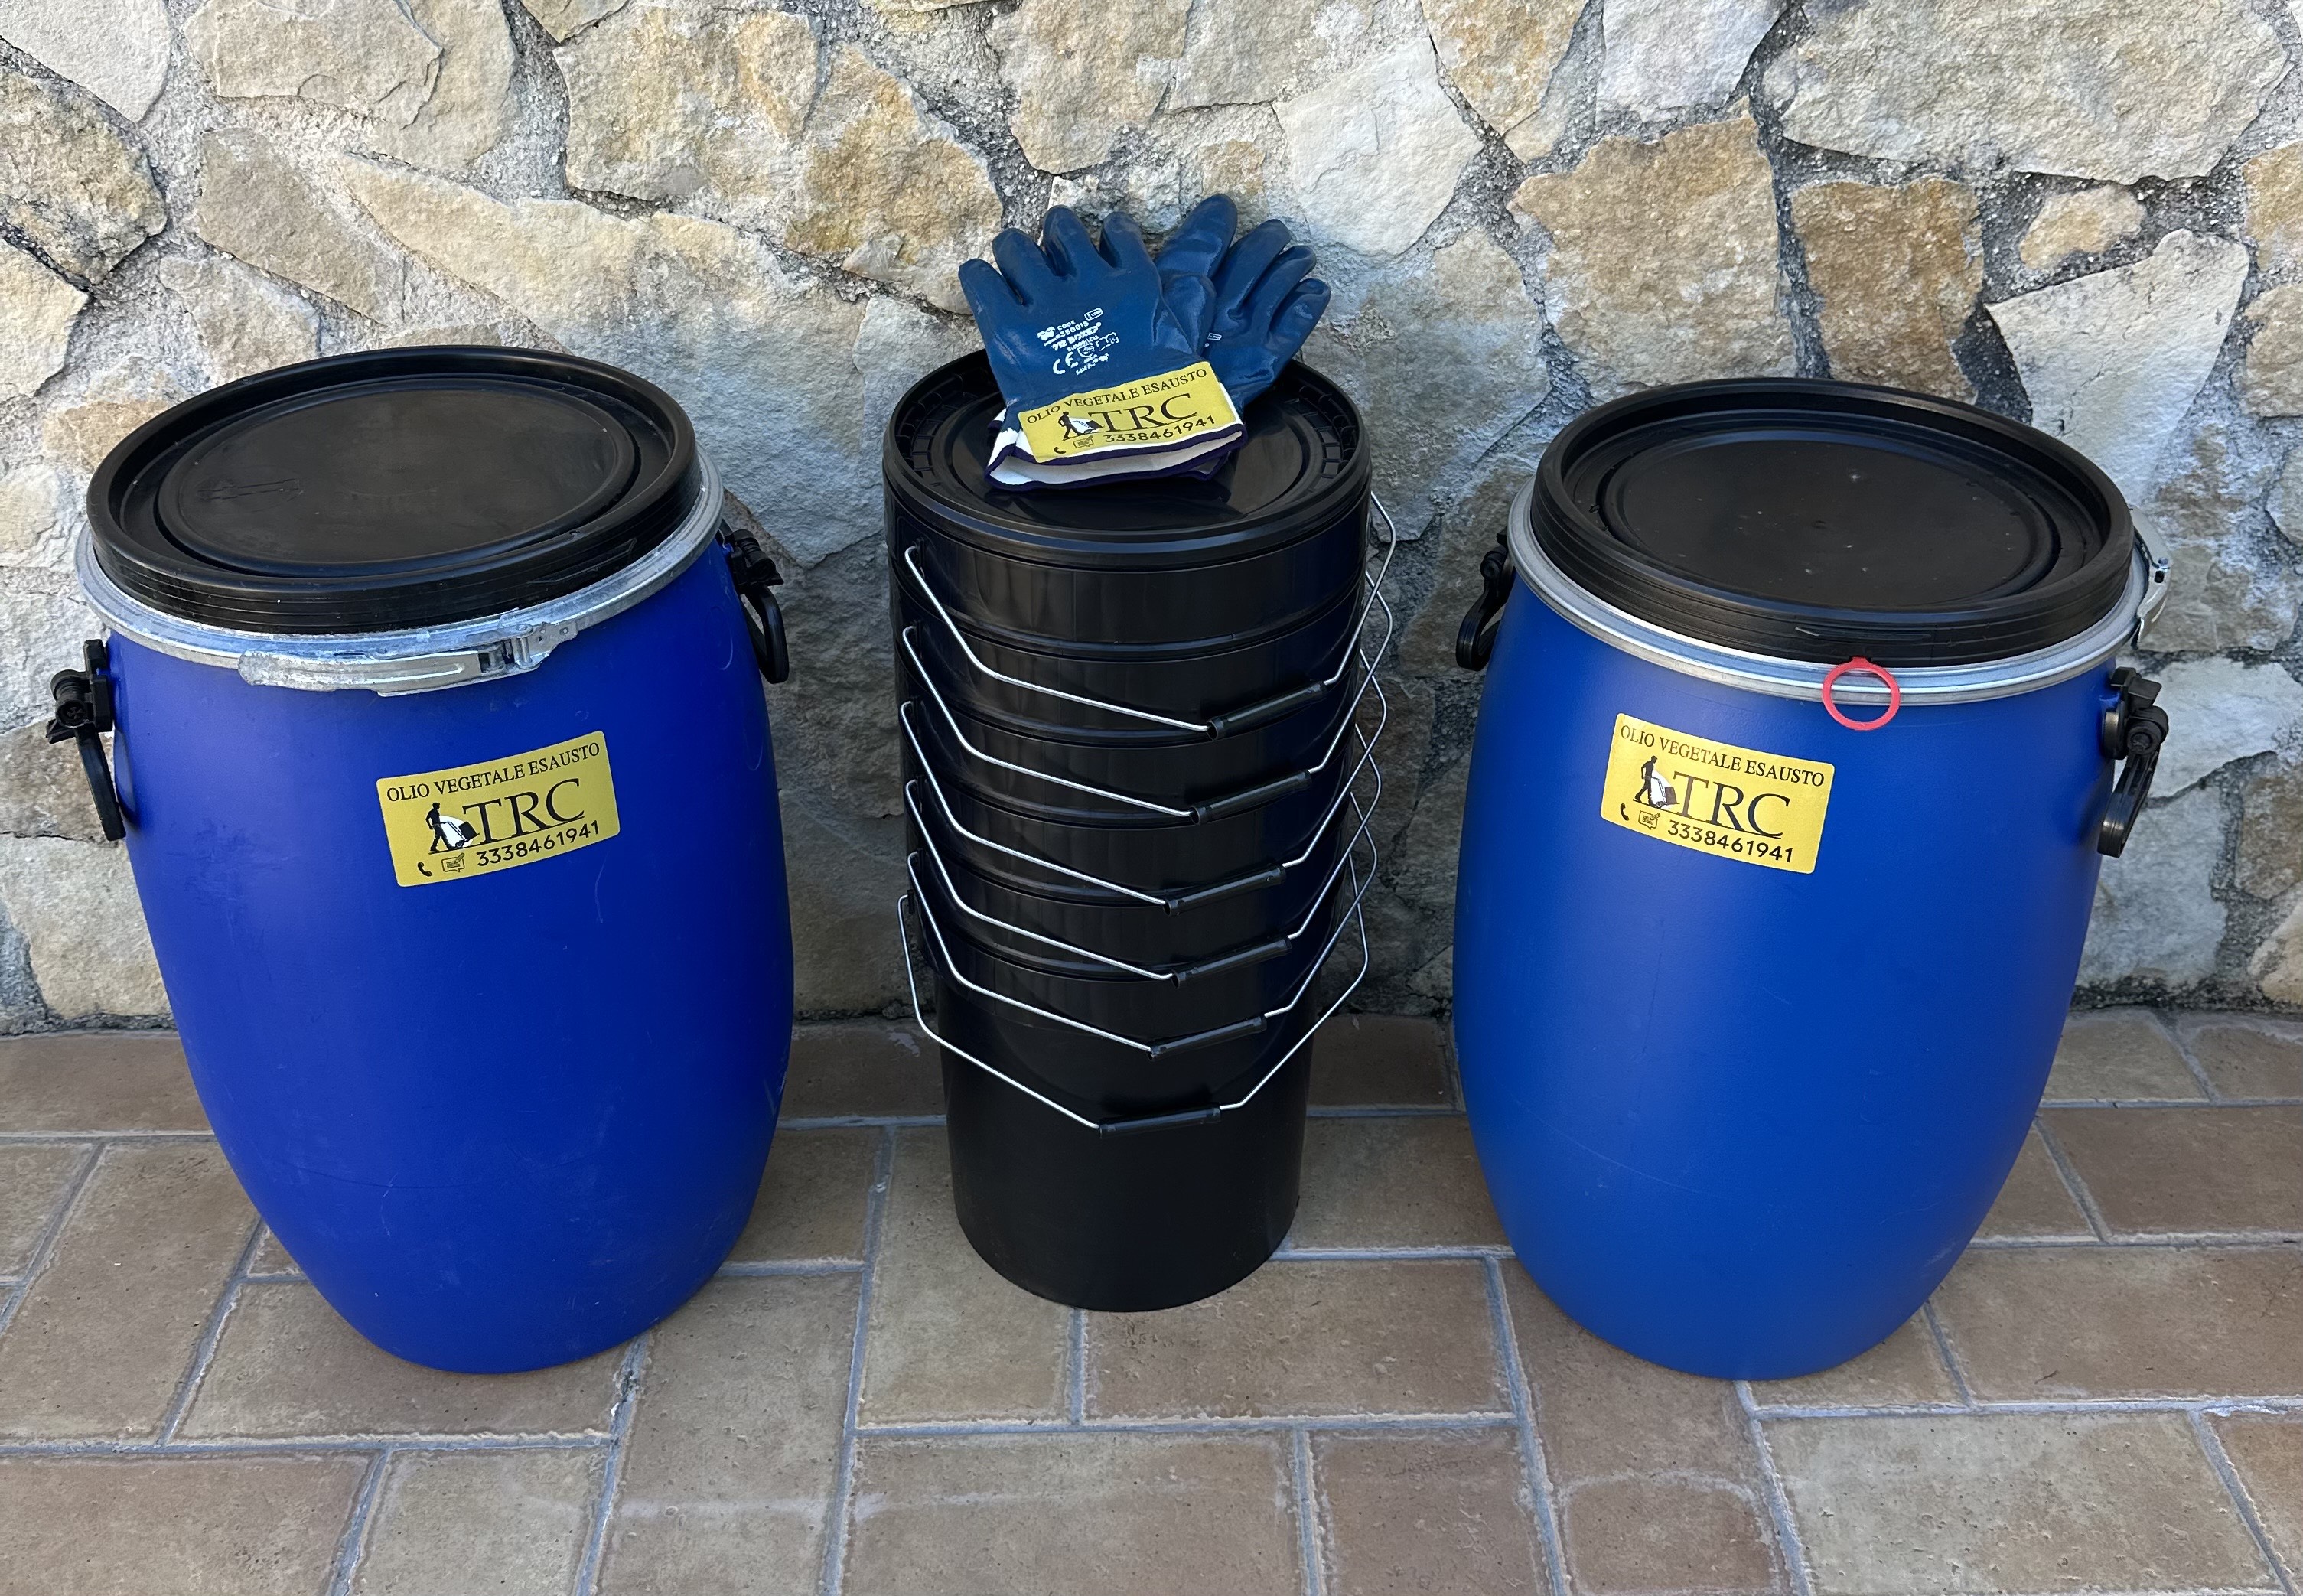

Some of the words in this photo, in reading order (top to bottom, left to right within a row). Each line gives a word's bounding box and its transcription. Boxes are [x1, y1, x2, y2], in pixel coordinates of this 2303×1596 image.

[1027, 406, 1060, 424] OLIO
[1063, 388, 1140, 408] VEGETALE
[1141, 369, 1207, 395] ESAUSTO
[1088, 393, 1198, 432] TRC
[1103, 415, 1215, 443] 3338461941
[386, 783, 430, 802] OLIO
[433, 764, 526, 795] VEGETALE
[529, 742, 600, 776] ESAUSTO
[1621, 725, 1655, 748] OLIO
[1659, 737, 1742, 771] VEGETALE
[1744, 761, 1826, 787] ESAUSTO
[462, 778, 585, 845] TRC
[1673, 770, 1790, 837] TRC
[476, 820, 600, 867] 3338461941
[1667, 819, 1793, 863] 3338461941
